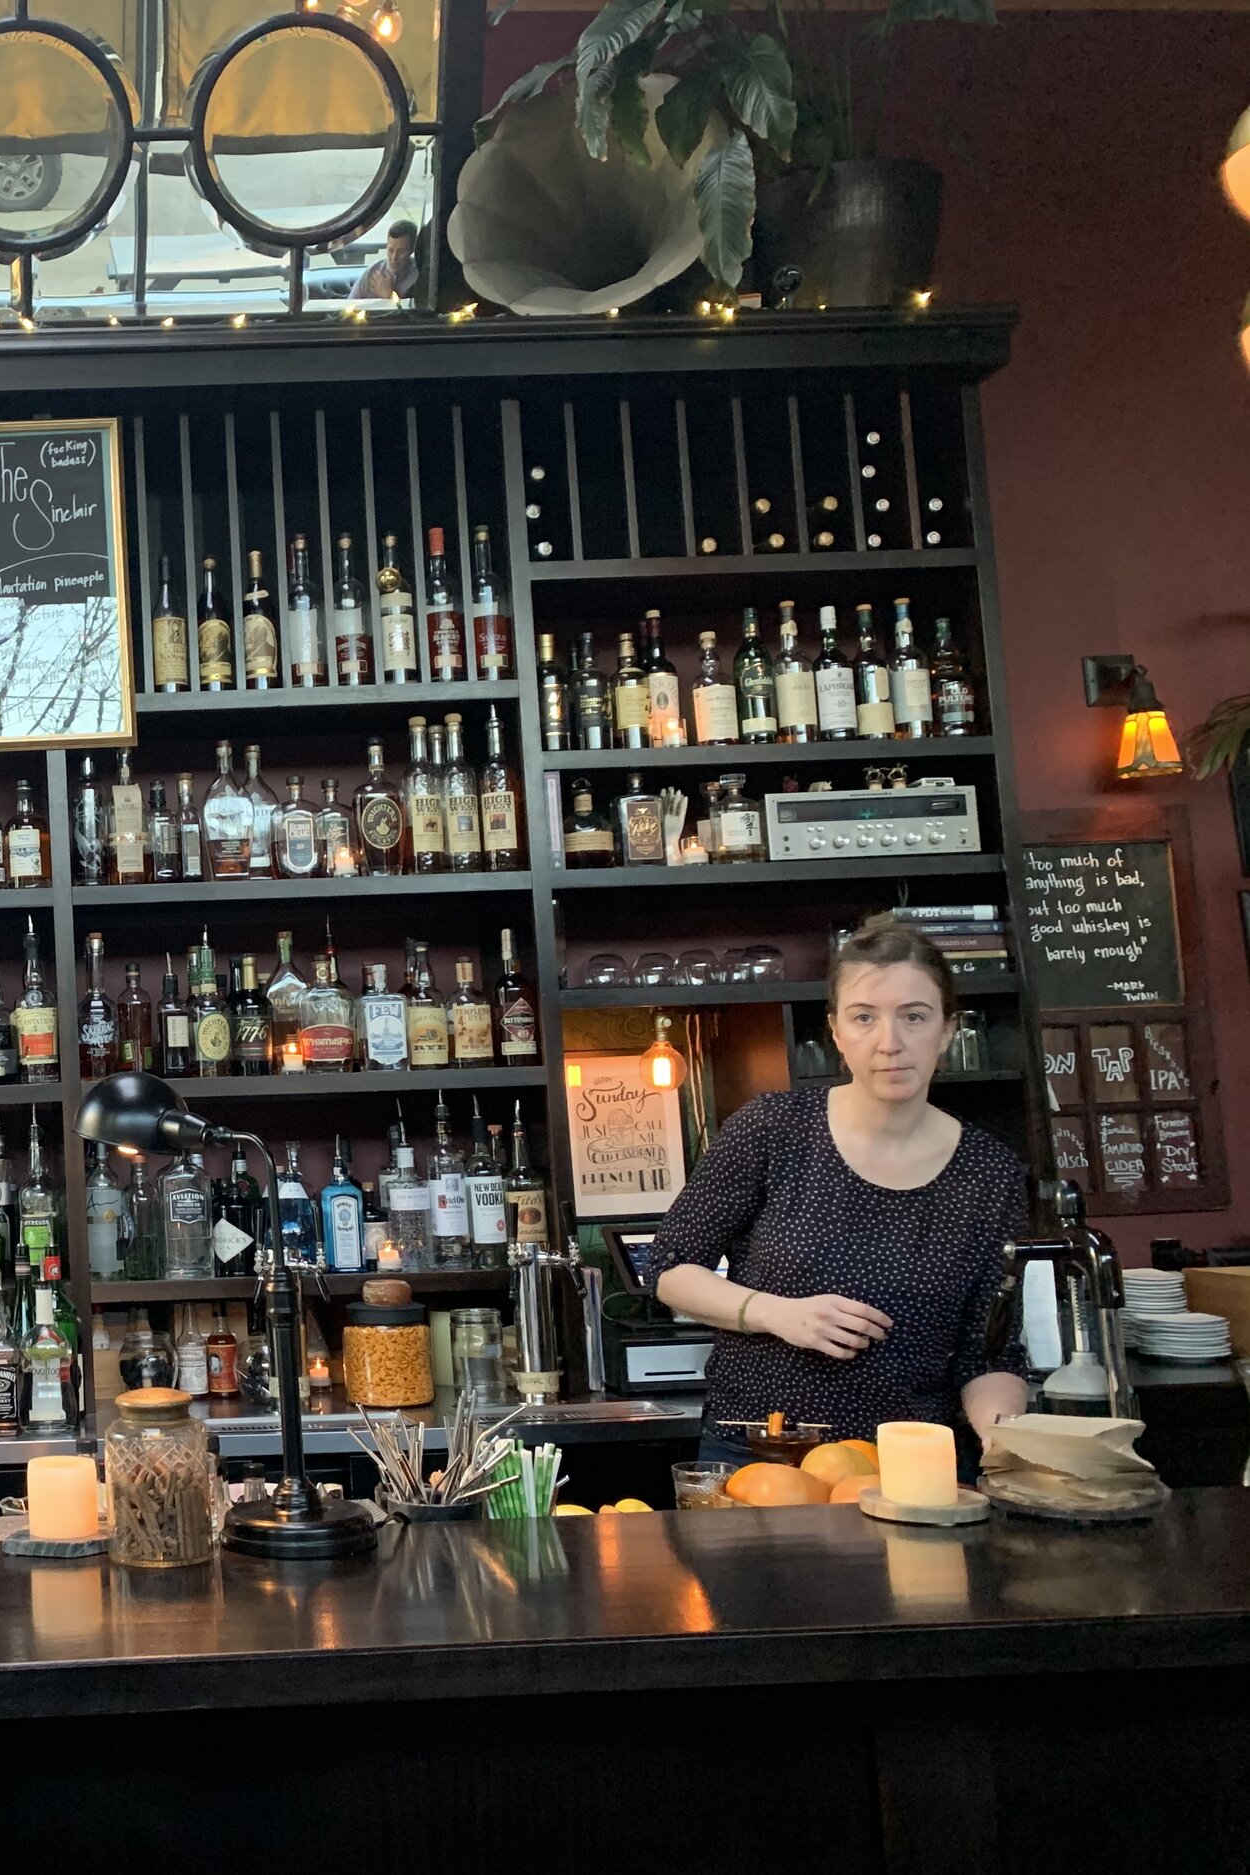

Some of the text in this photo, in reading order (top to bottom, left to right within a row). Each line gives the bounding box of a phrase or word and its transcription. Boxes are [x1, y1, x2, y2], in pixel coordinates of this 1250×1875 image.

[13, 479, 97, 550] Sinclair
[819, 682, 854, 693] LAPHROA
[449, 796, 478, 806] HIGH
[450, 804, 478, 812] WEST
[483, 795, 511, 805] HIGH
[1060, 852, 1099, 868] much
[1107, 848, 1124, 867] of
[1025, 873, 1086, 896] anything
[1095, 873, 1108, 887] is
[1057, 900, 1081, 915] too
[1086, 898, 1122, 913] much
[1030, 915, 1152, 943] good whiskey is
[1045, 945, 1086, 964] barely
[1122, 991, 1159, 1002] TWAIN
[372, 1004, 399, 1015] FEW
[236, 1025, 269, 1043] 1776
[1044, 1047, 1134, 1082] ON TAP
[1150, 1069, 1181, 1091] IPA
[576, 1080, 662, 1122] Sunday
[580, 1120, 663, 1141] JUST CALL
[1057, 1151, 1089, 1169] olsch
[1162, 1144, 1190, 1163] Dry
[1105, 1159, 1145, 1172] CIDER
[1161, 1157, 1199, 1174] Stout
[474, 1182, 490, 1192] NEW
[638, 1168, 671, 1192] DIP
[171, 1192, 205, 1200] AVIATION
